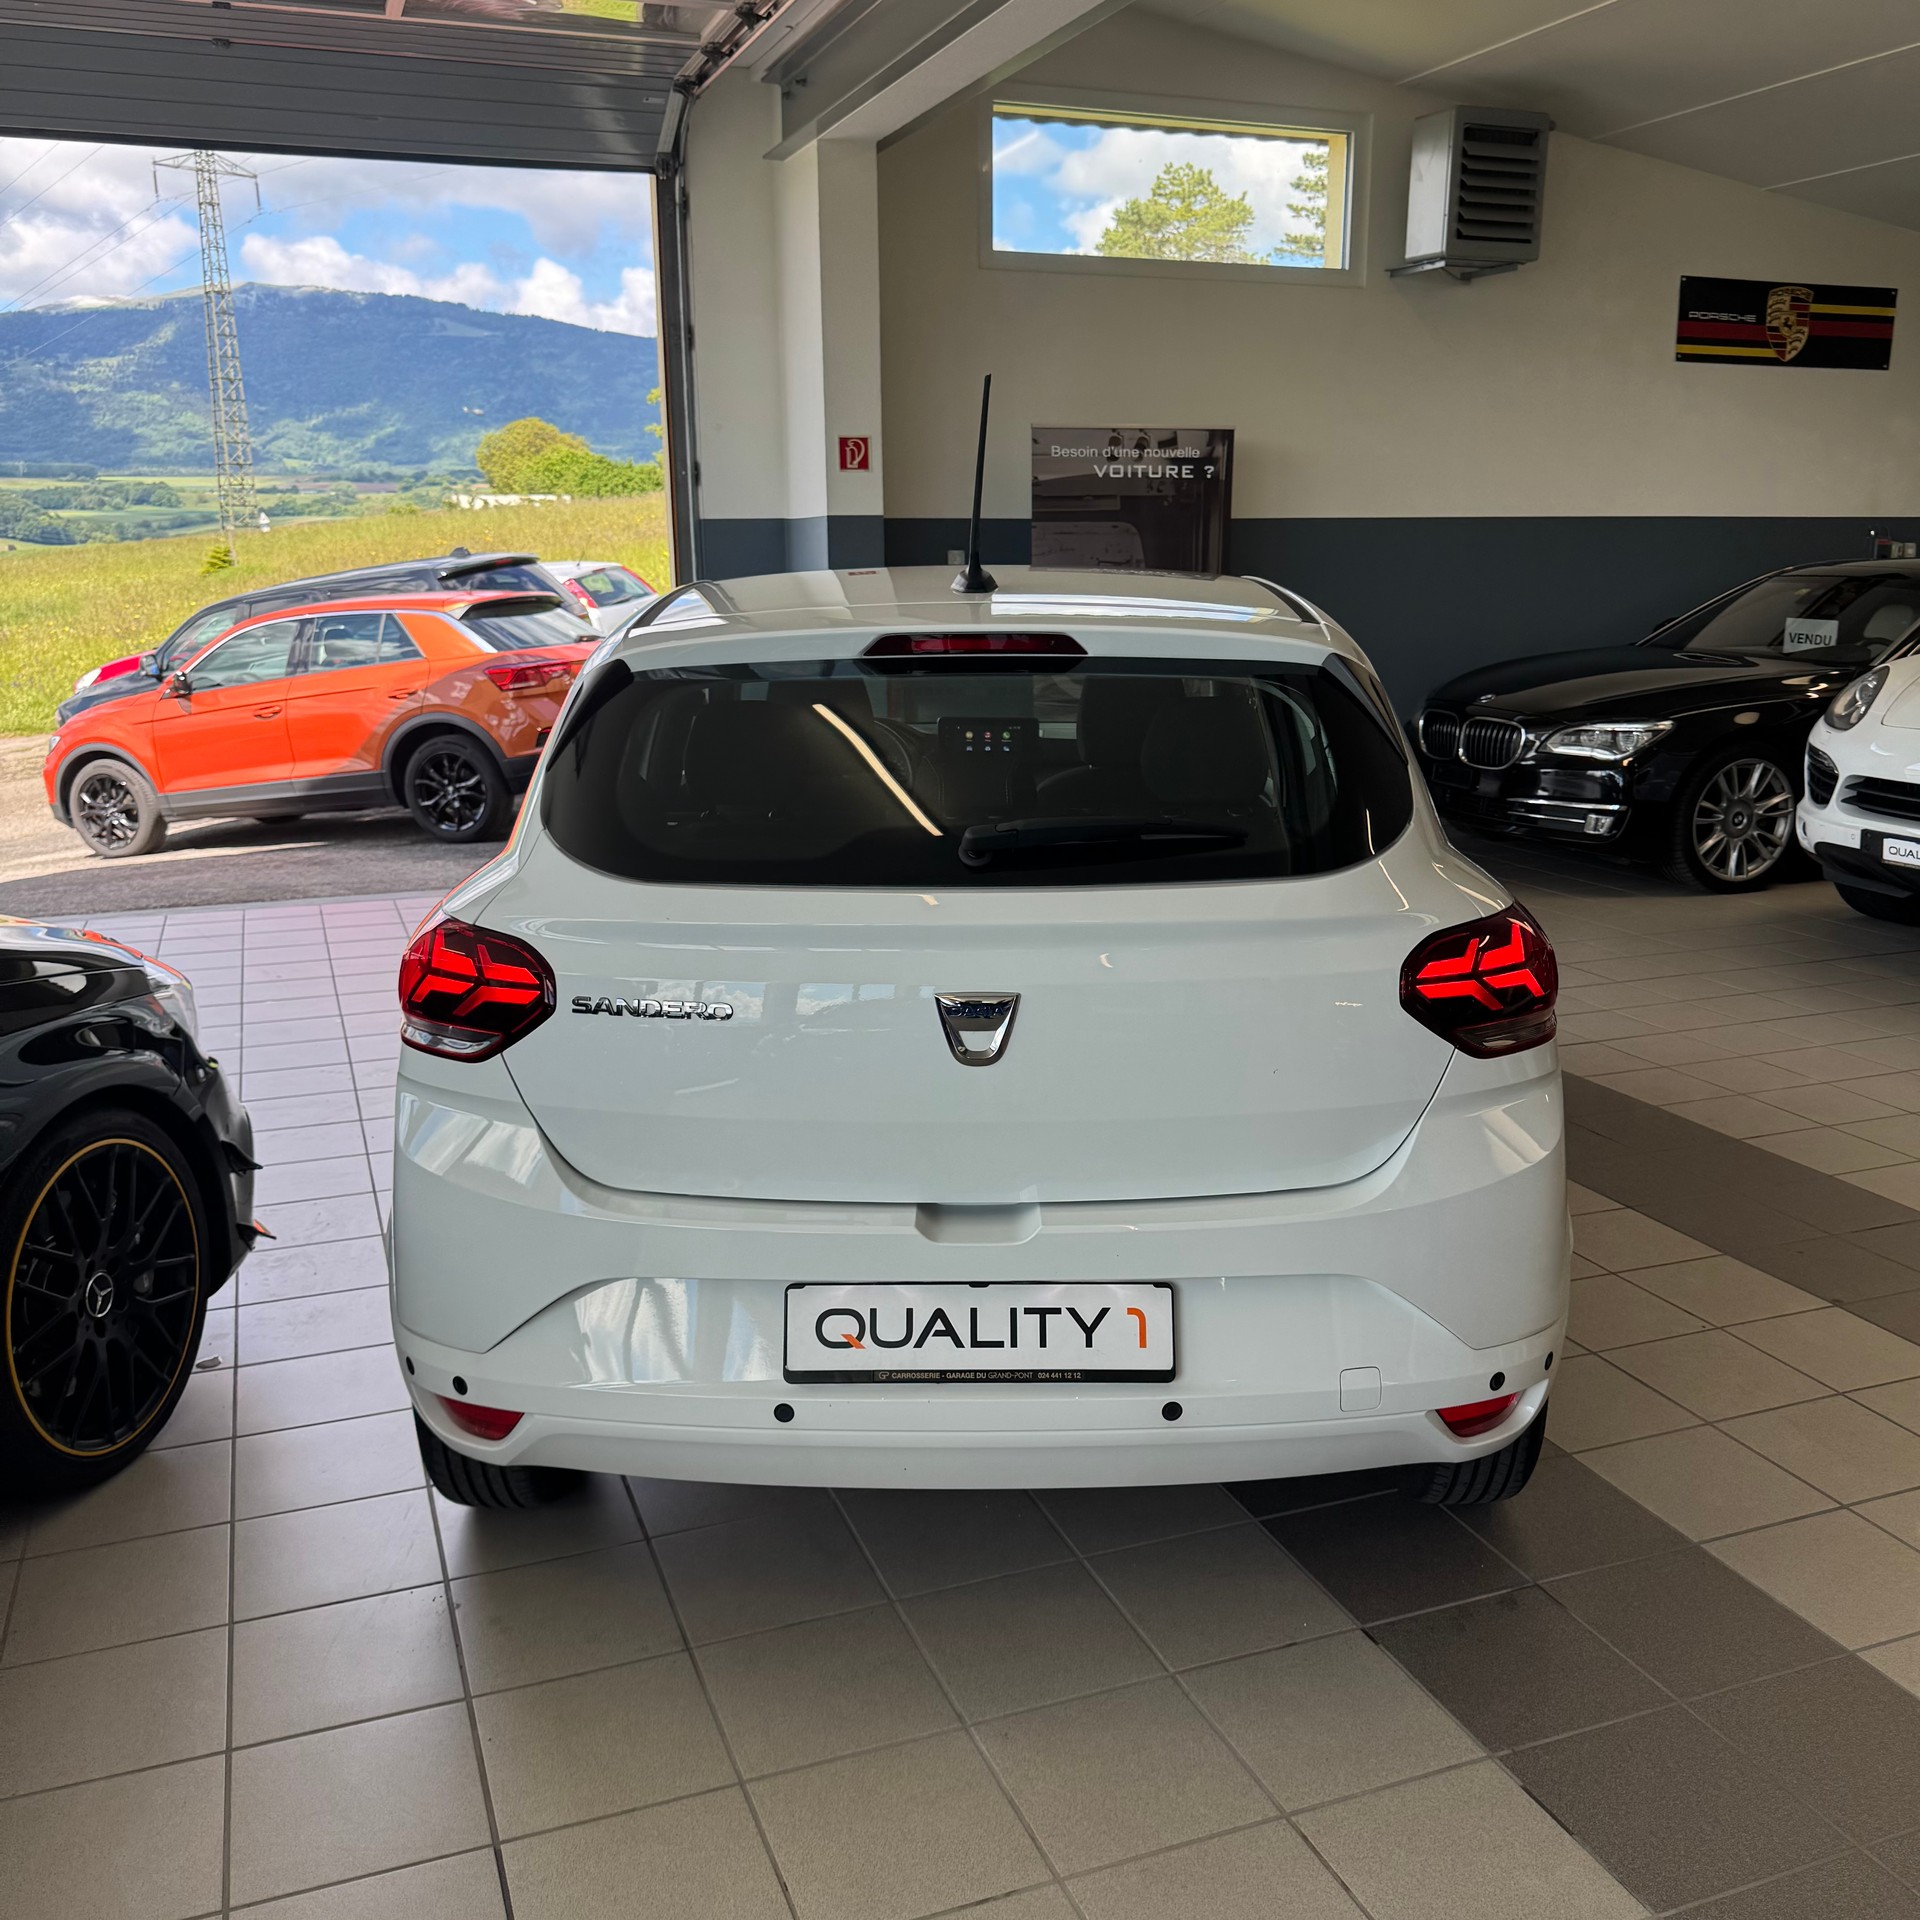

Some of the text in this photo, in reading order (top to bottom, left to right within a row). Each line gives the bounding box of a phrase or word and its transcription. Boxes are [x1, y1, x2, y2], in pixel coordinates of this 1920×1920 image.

[1688, 311, 1757, 322] PORSCHE
[1051, 445, 1200, 459] Besoin d'une nouvelle
[1093, 465, 1215, 479] VOITURE ?
[1788, 632, 1832, 646] VENDU
[571, 995, 734, 1021] SANDERO
[814, 1307, 1148, 1350] QUALITY 1
